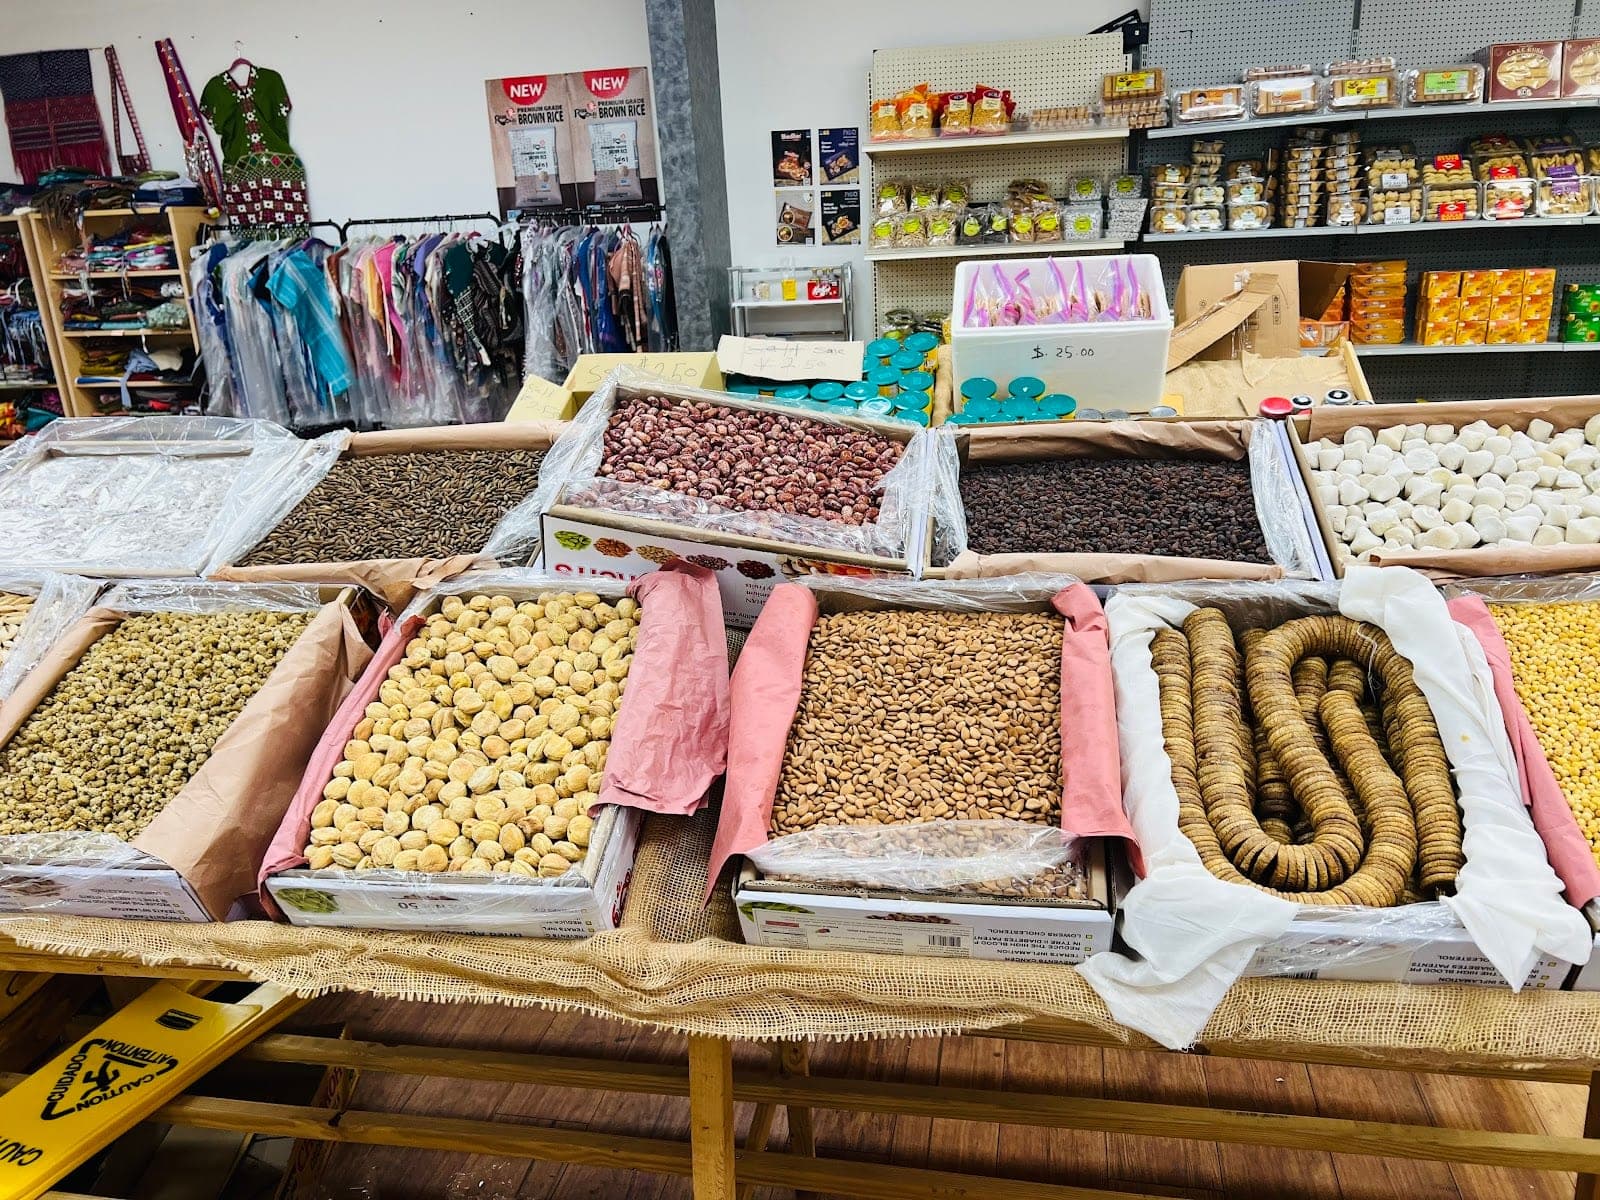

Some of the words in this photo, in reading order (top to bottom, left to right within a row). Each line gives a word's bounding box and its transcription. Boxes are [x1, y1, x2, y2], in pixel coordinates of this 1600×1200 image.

[510, 83, 543, 98] NEW
[591, 76, 625, 91] NEW
[518, 111, 546, 125] BROWN
[546, 110, 564, 123] RICE
[599, 105, 627, 119] BROWN
[628, 103, 646, 117] RICE
[987, 928, 1046, 937] CHOLESTEROL
[1438, 954, 1490, 962] OLESTEROL
[1438, 977, 1497, 985] INFLAMATION
[100, 1039, 176, 1064] ATTENTION
[46, 1053, 87, 1102] CUIDADO
[74, 1074, 156, 1112] CAUTION
[0, 1135, 43, 1167] CAU
